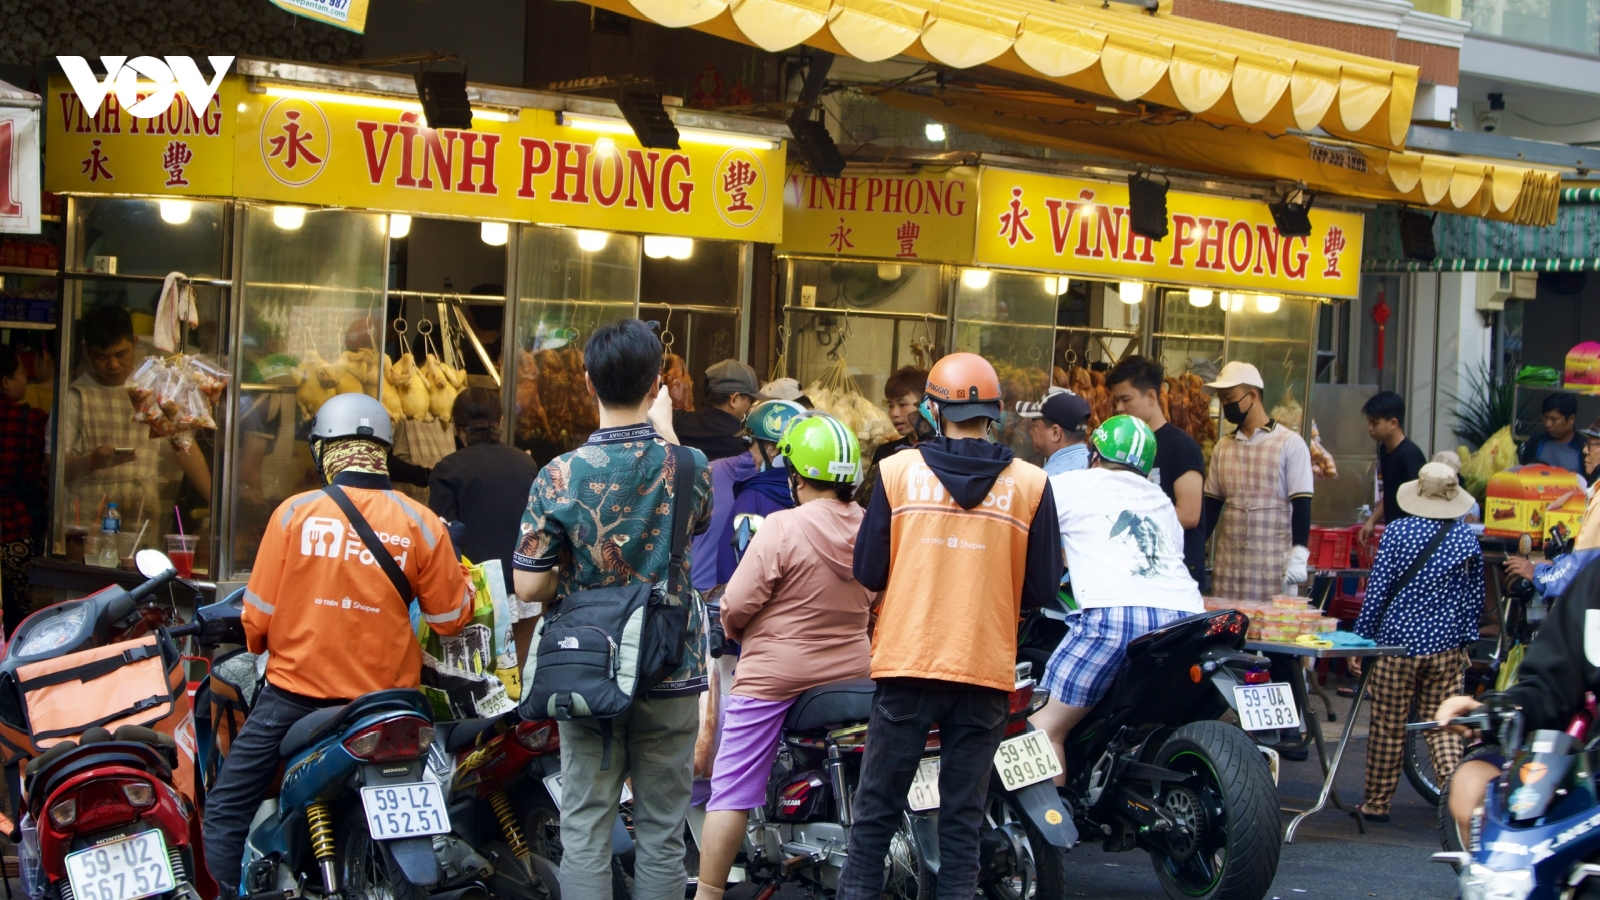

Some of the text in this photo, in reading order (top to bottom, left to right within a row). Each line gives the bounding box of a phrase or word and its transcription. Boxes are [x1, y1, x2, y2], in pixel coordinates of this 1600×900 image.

[268, 110, 323, 169] 永
[81, 140, 193, 187] 永 豐
[357, 112, 694, 213] VĨNH PHONG
[723, 159, 757, 213] 豐
[865, 177, 966, 217] PHONG
[999, 188, 1035, 247] 永
[829, 217, 921, 258] 永 豐
[1169, 214, 1310, 279] PHONG
[1322, 226, 1346, 278] 豐
[344, 540, 408, 572] Fod
[960, 540, 986, 550] Shopee
[353, 601, 380, 613] Shopee
[1243, 687, 1285, 707] 59-UA
[1245, 707, 1294, 727] 115.83
[1000, 736, 1042, 764] 59-H1
[1003, 754, 1057, 787] 899.64
[374, 787, 432, 811] 59-L2
[373, 809, 442, 836] 152.51
[81, 837, 152, 879] 59-U2
[81, 863, 167, 900] 567.52
